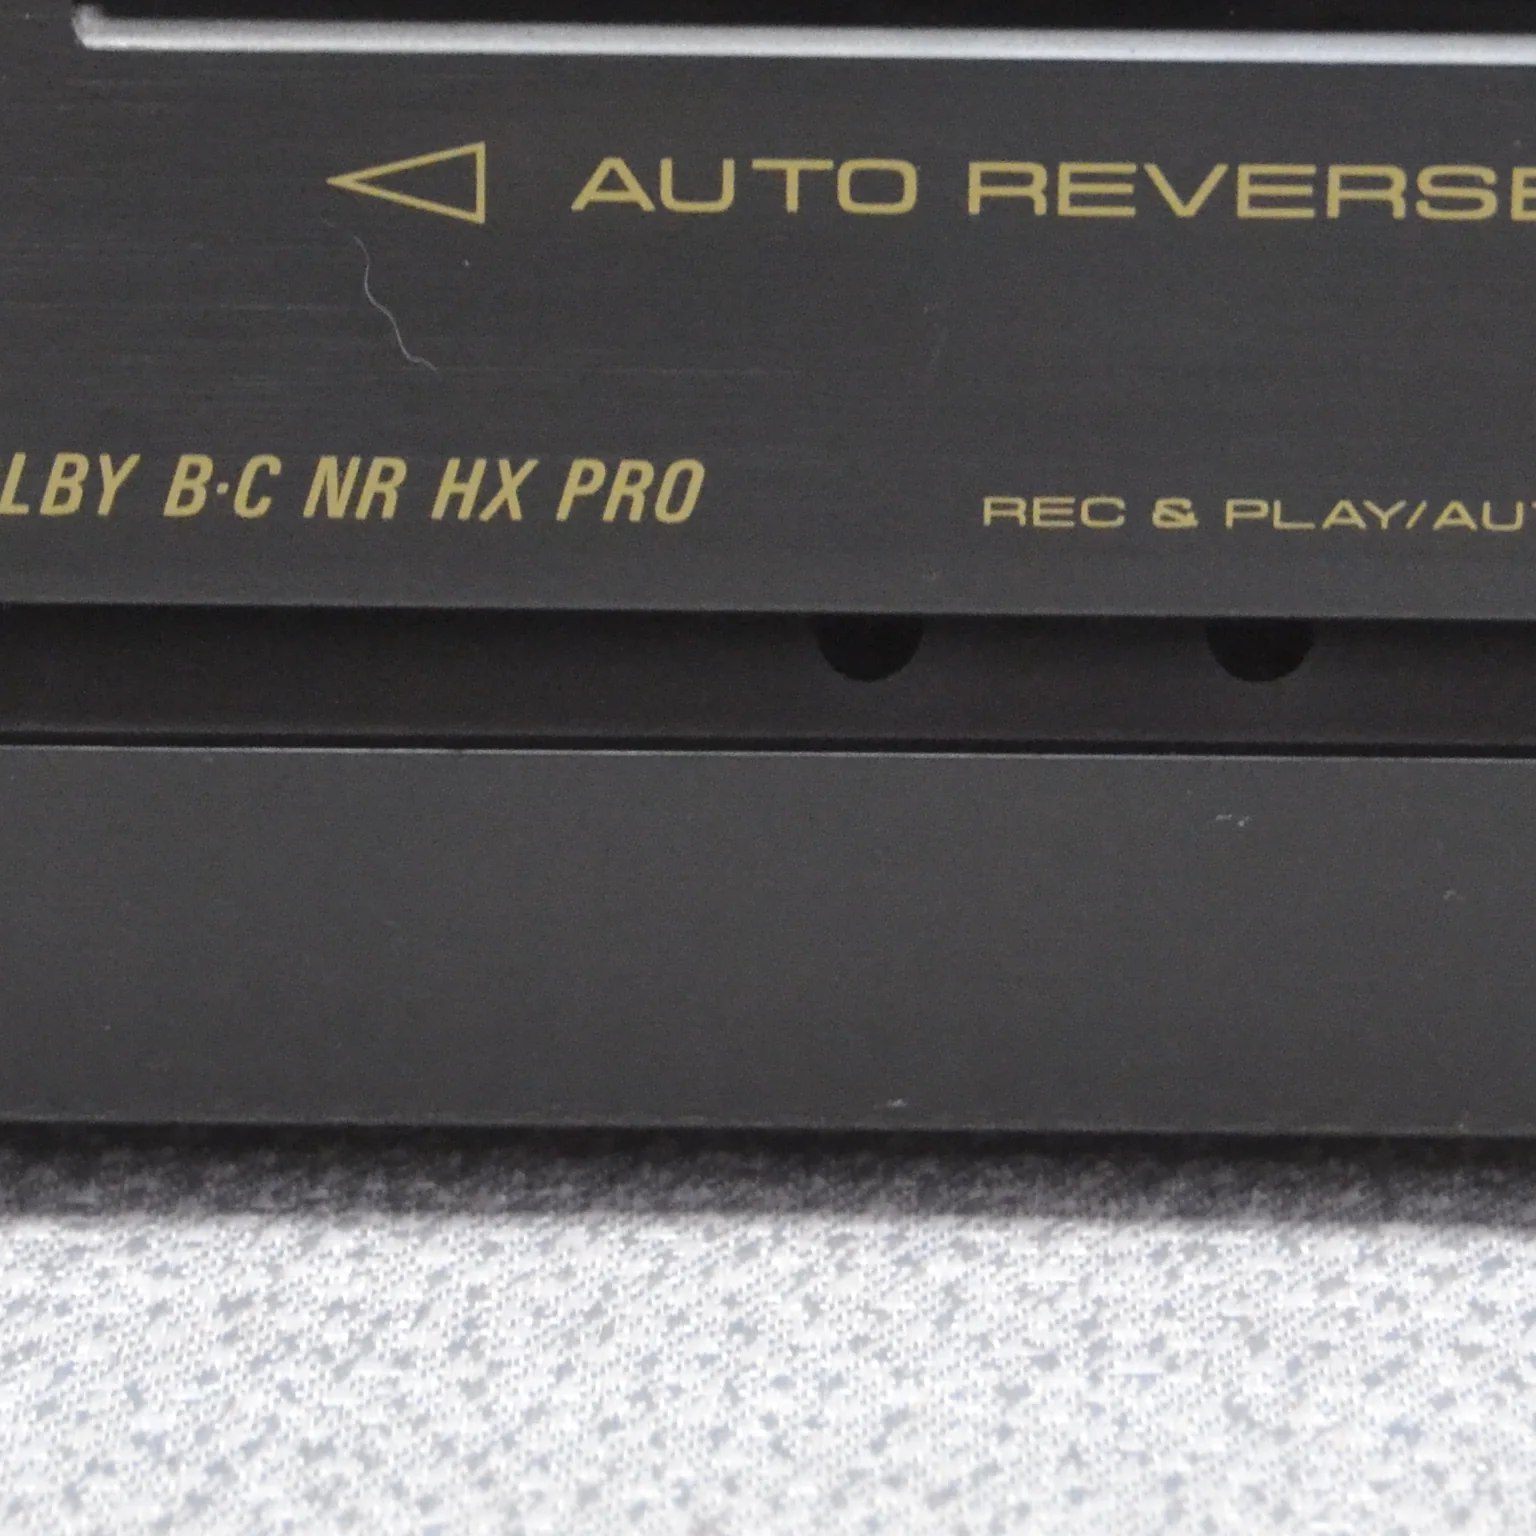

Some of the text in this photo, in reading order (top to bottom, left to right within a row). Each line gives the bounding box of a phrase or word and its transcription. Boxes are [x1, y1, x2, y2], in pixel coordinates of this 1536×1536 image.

[571, 157, 918, 215] AUTO
[303, 455, 408, 520] NR
[431, 457, 539, 522] HX
[556, 458, 706, 524] PRO
[982, 495, 1126, 529] REC
[1151, 497, 1199, 529] &
